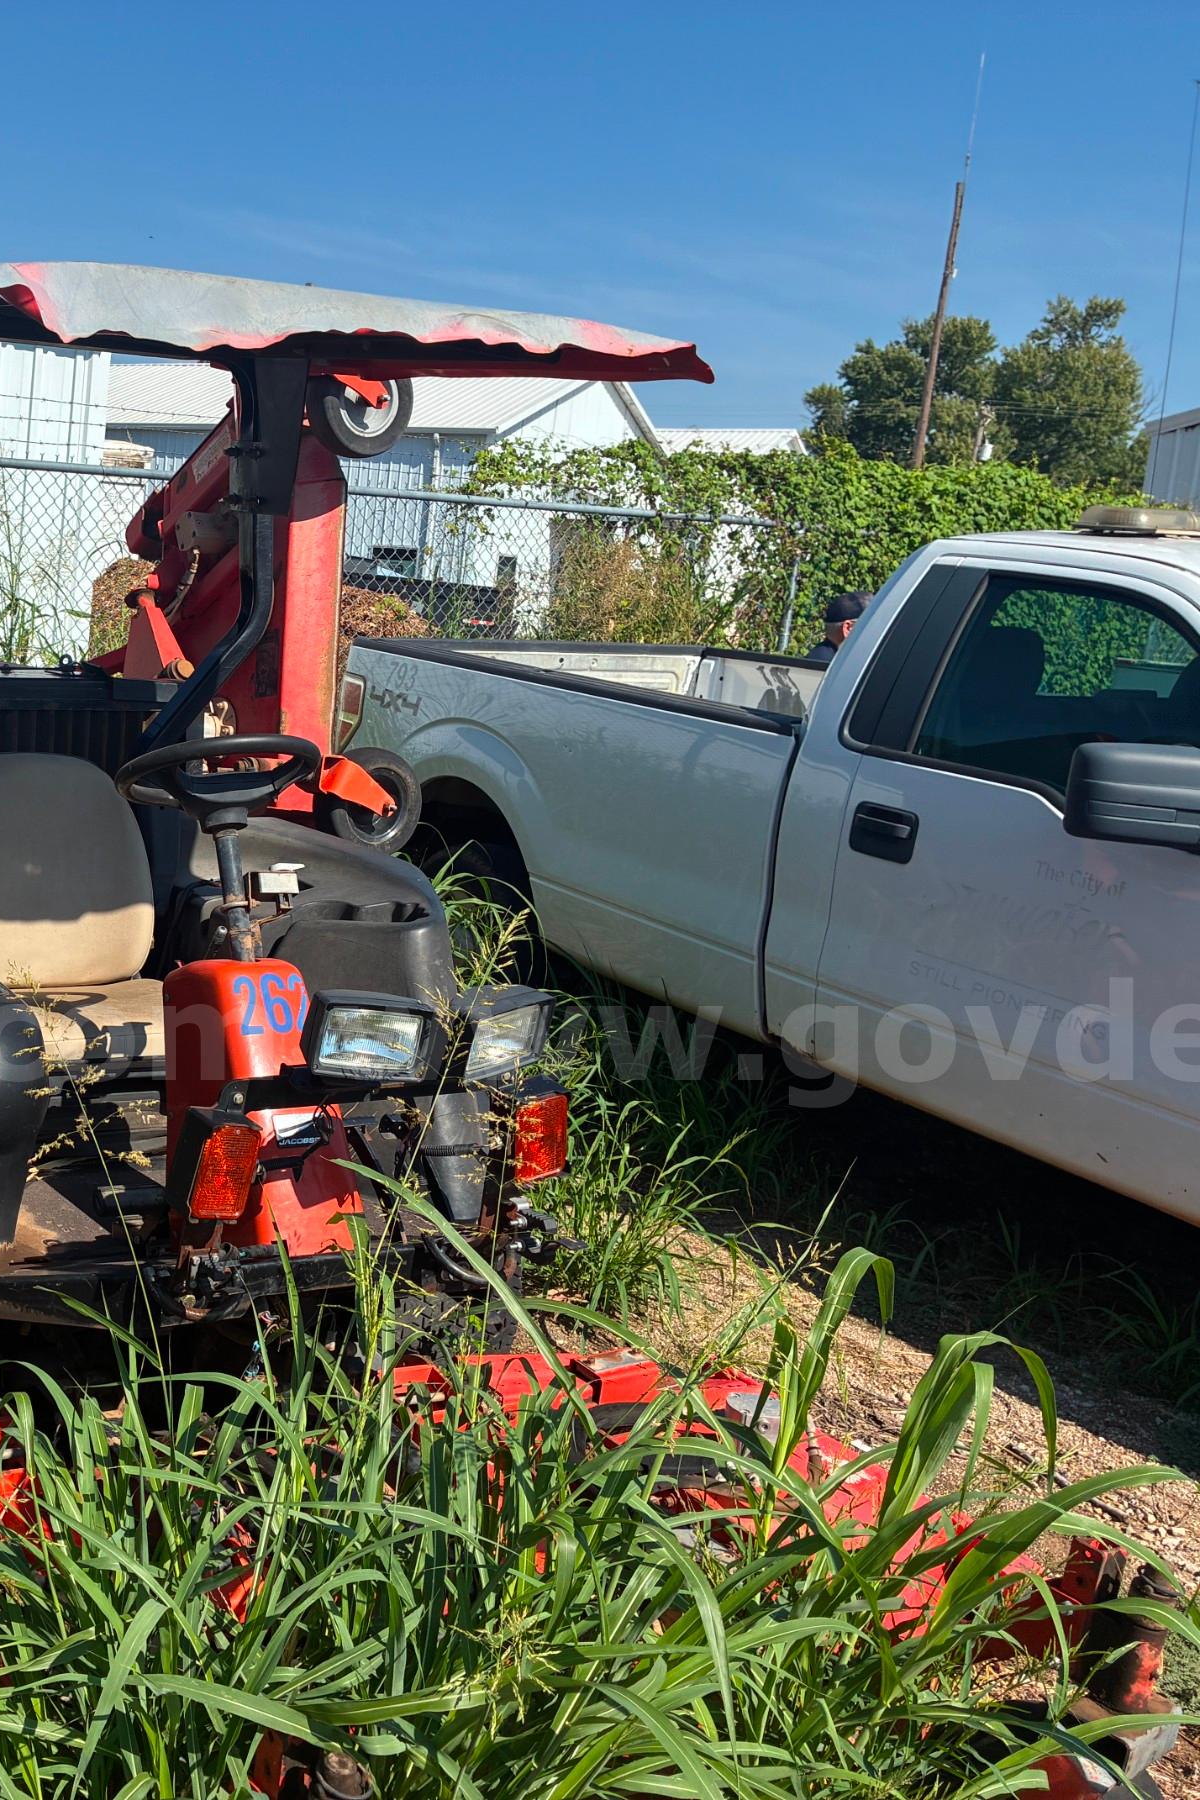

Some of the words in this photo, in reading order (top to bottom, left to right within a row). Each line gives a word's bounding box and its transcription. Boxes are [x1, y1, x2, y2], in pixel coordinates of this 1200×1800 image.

[385, 662, 418, 689] 793
[1035, 861, 1066, 883] The
[1070, 871, 1105, 897] City
[1106, 882, 1128, 899] of
[908, 960, 963, 991] STILL
[970, 983, 1108, 1041] PIONEERING
